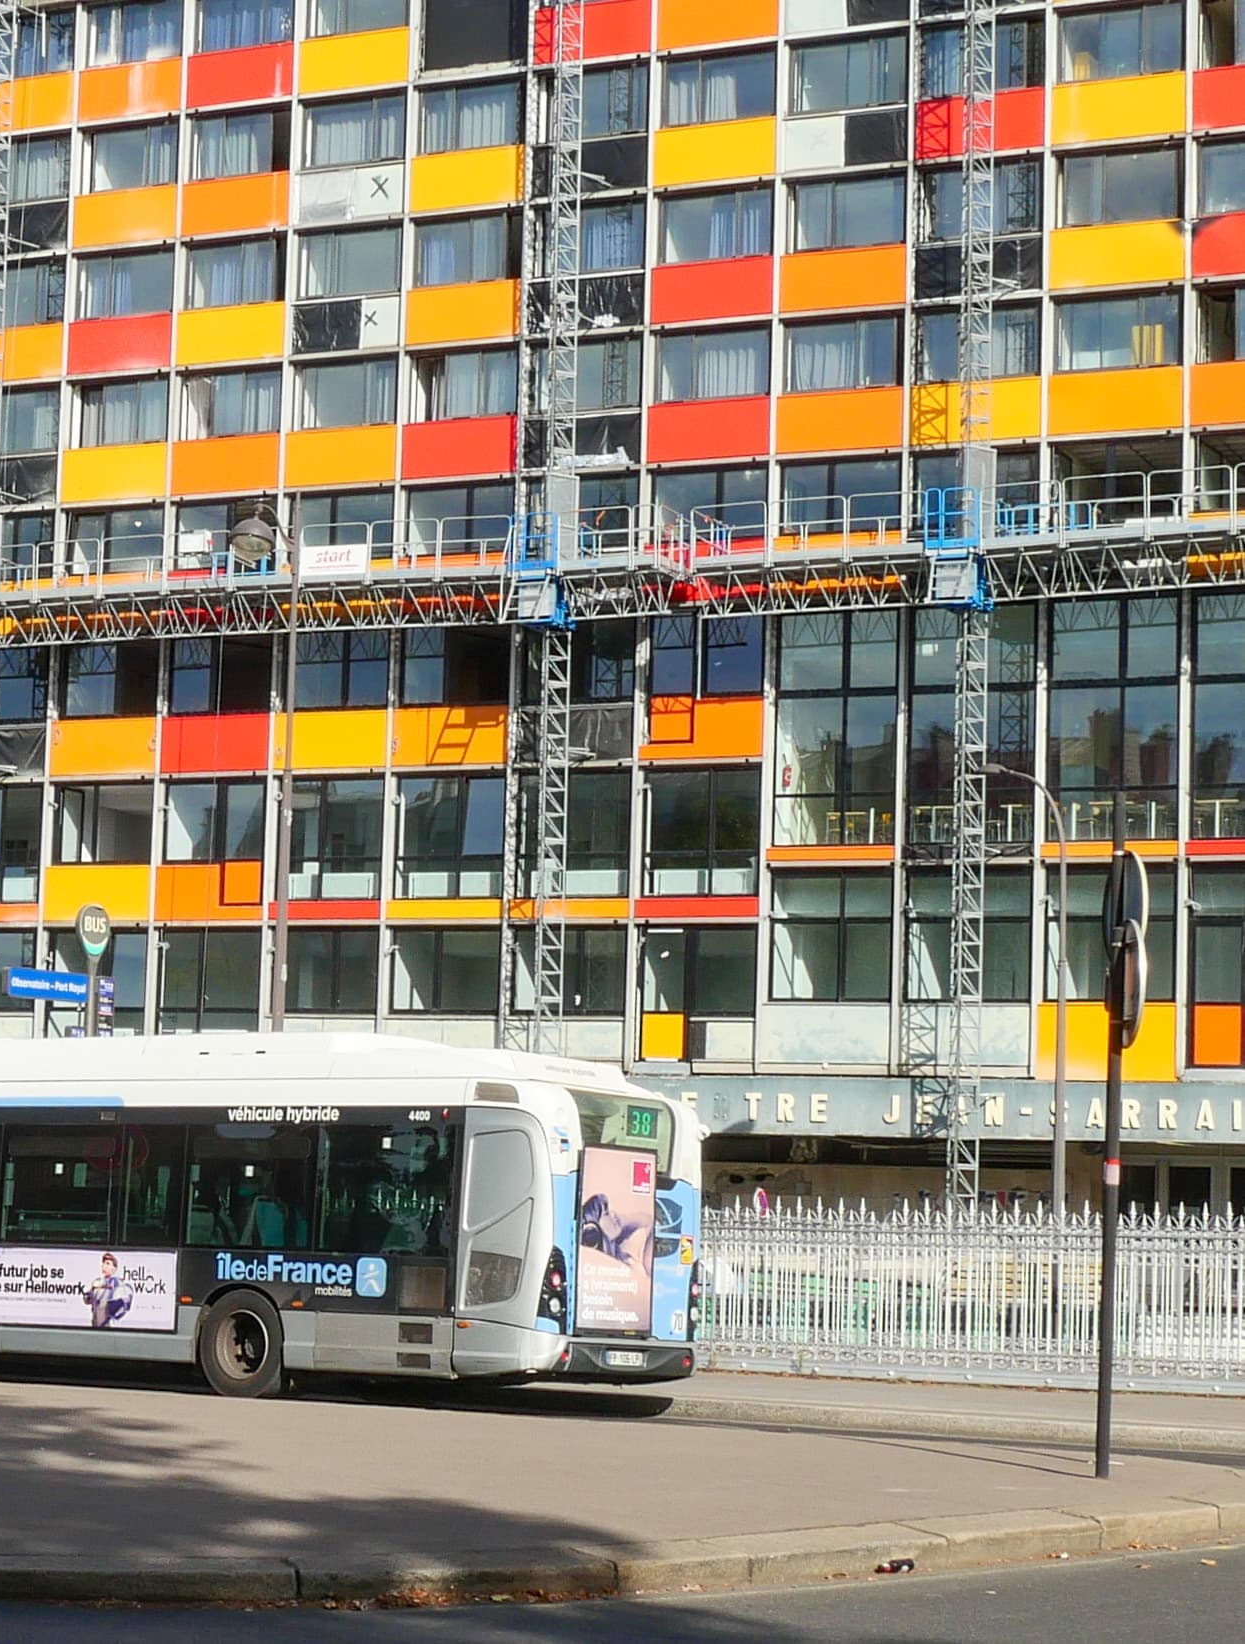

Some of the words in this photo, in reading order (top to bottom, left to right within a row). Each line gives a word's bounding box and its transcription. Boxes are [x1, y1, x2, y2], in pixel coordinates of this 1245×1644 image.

[84, 915, 106, 933] BUS
[228, 1106, 283, 1121] véhicule
[286, 1106, 340, 1124] hybride
[408, 1110, 431, 1121] 4400
[631, 1110, 651, 1136] 38
[0, 1263, 28, 1278] futur
[29, 1263, 48, 1281] job
[50, 1268, 65, 1279] se
[4, 1282, 23, 1293] sur
[314, 1285, 353, 1298] mobilités
[673, 1312, 684, 1331] 70
